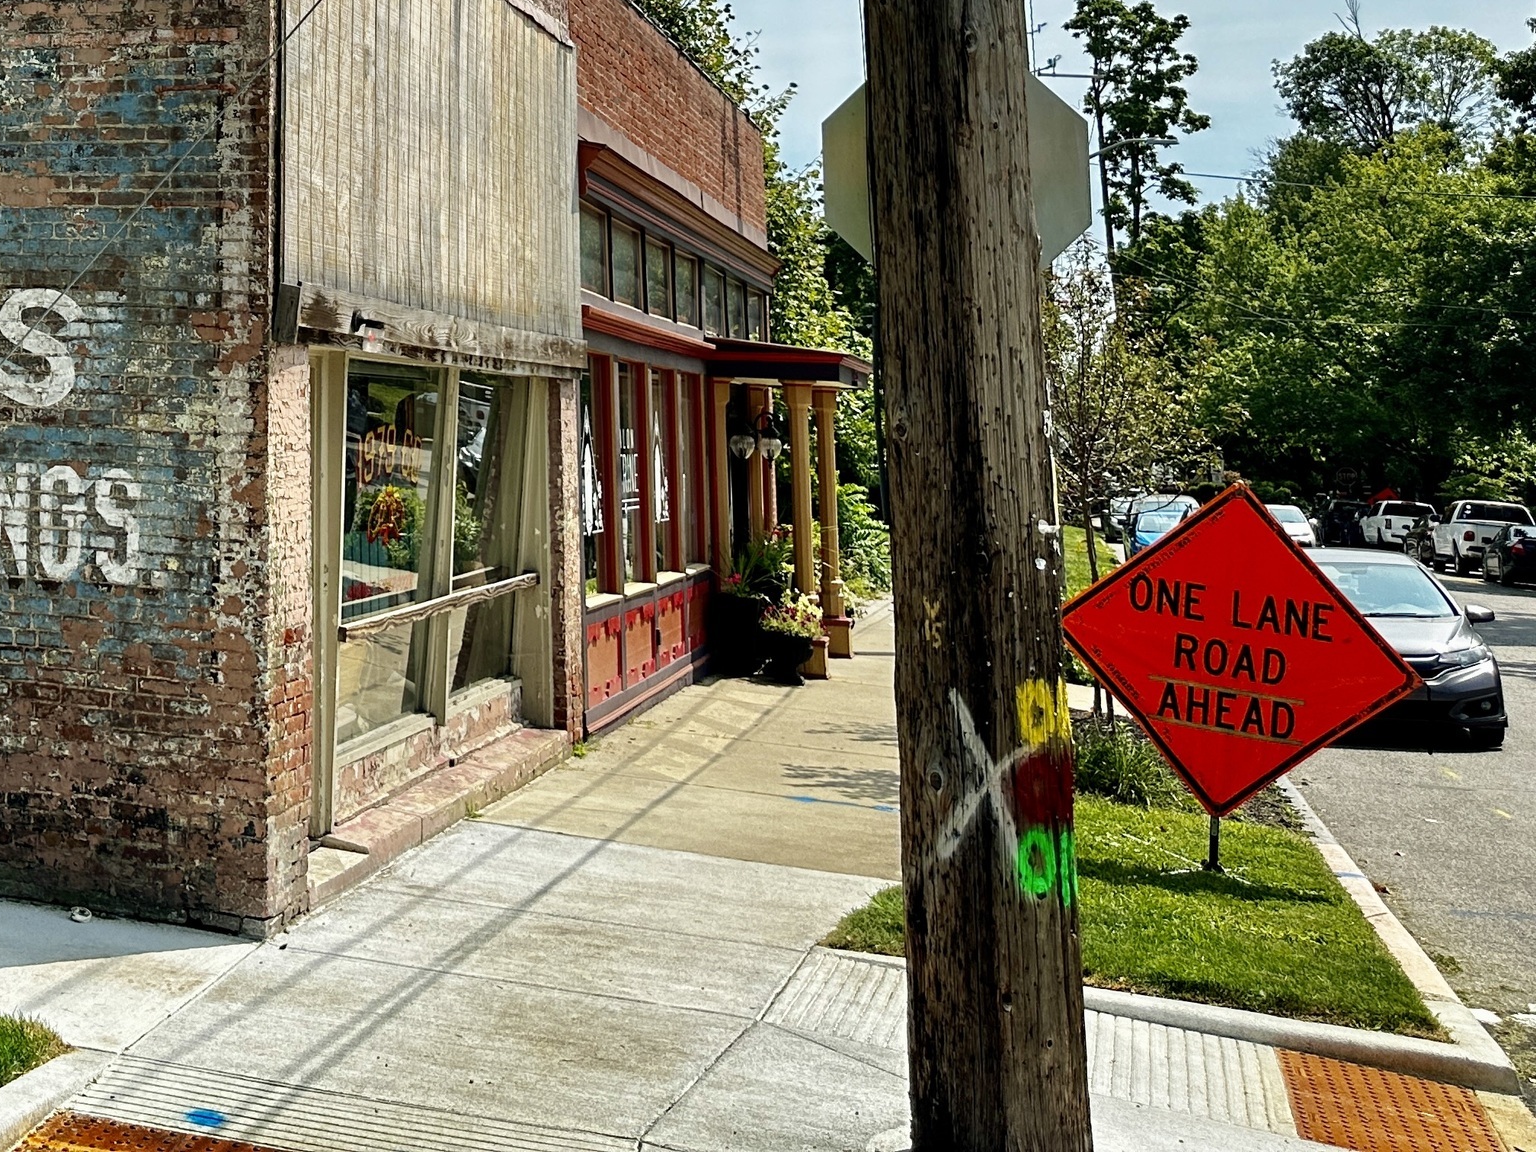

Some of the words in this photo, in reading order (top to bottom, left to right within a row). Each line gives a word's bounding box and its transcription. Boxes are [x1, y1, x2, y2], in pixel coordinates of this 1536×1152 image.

[1129, 571, 1207, 622] ONE
[1232, 589, 1336, 643] LANE
[1173, 632, 1287, 686] ROAD
[1155, 681, 1296, 740] AHEAD
